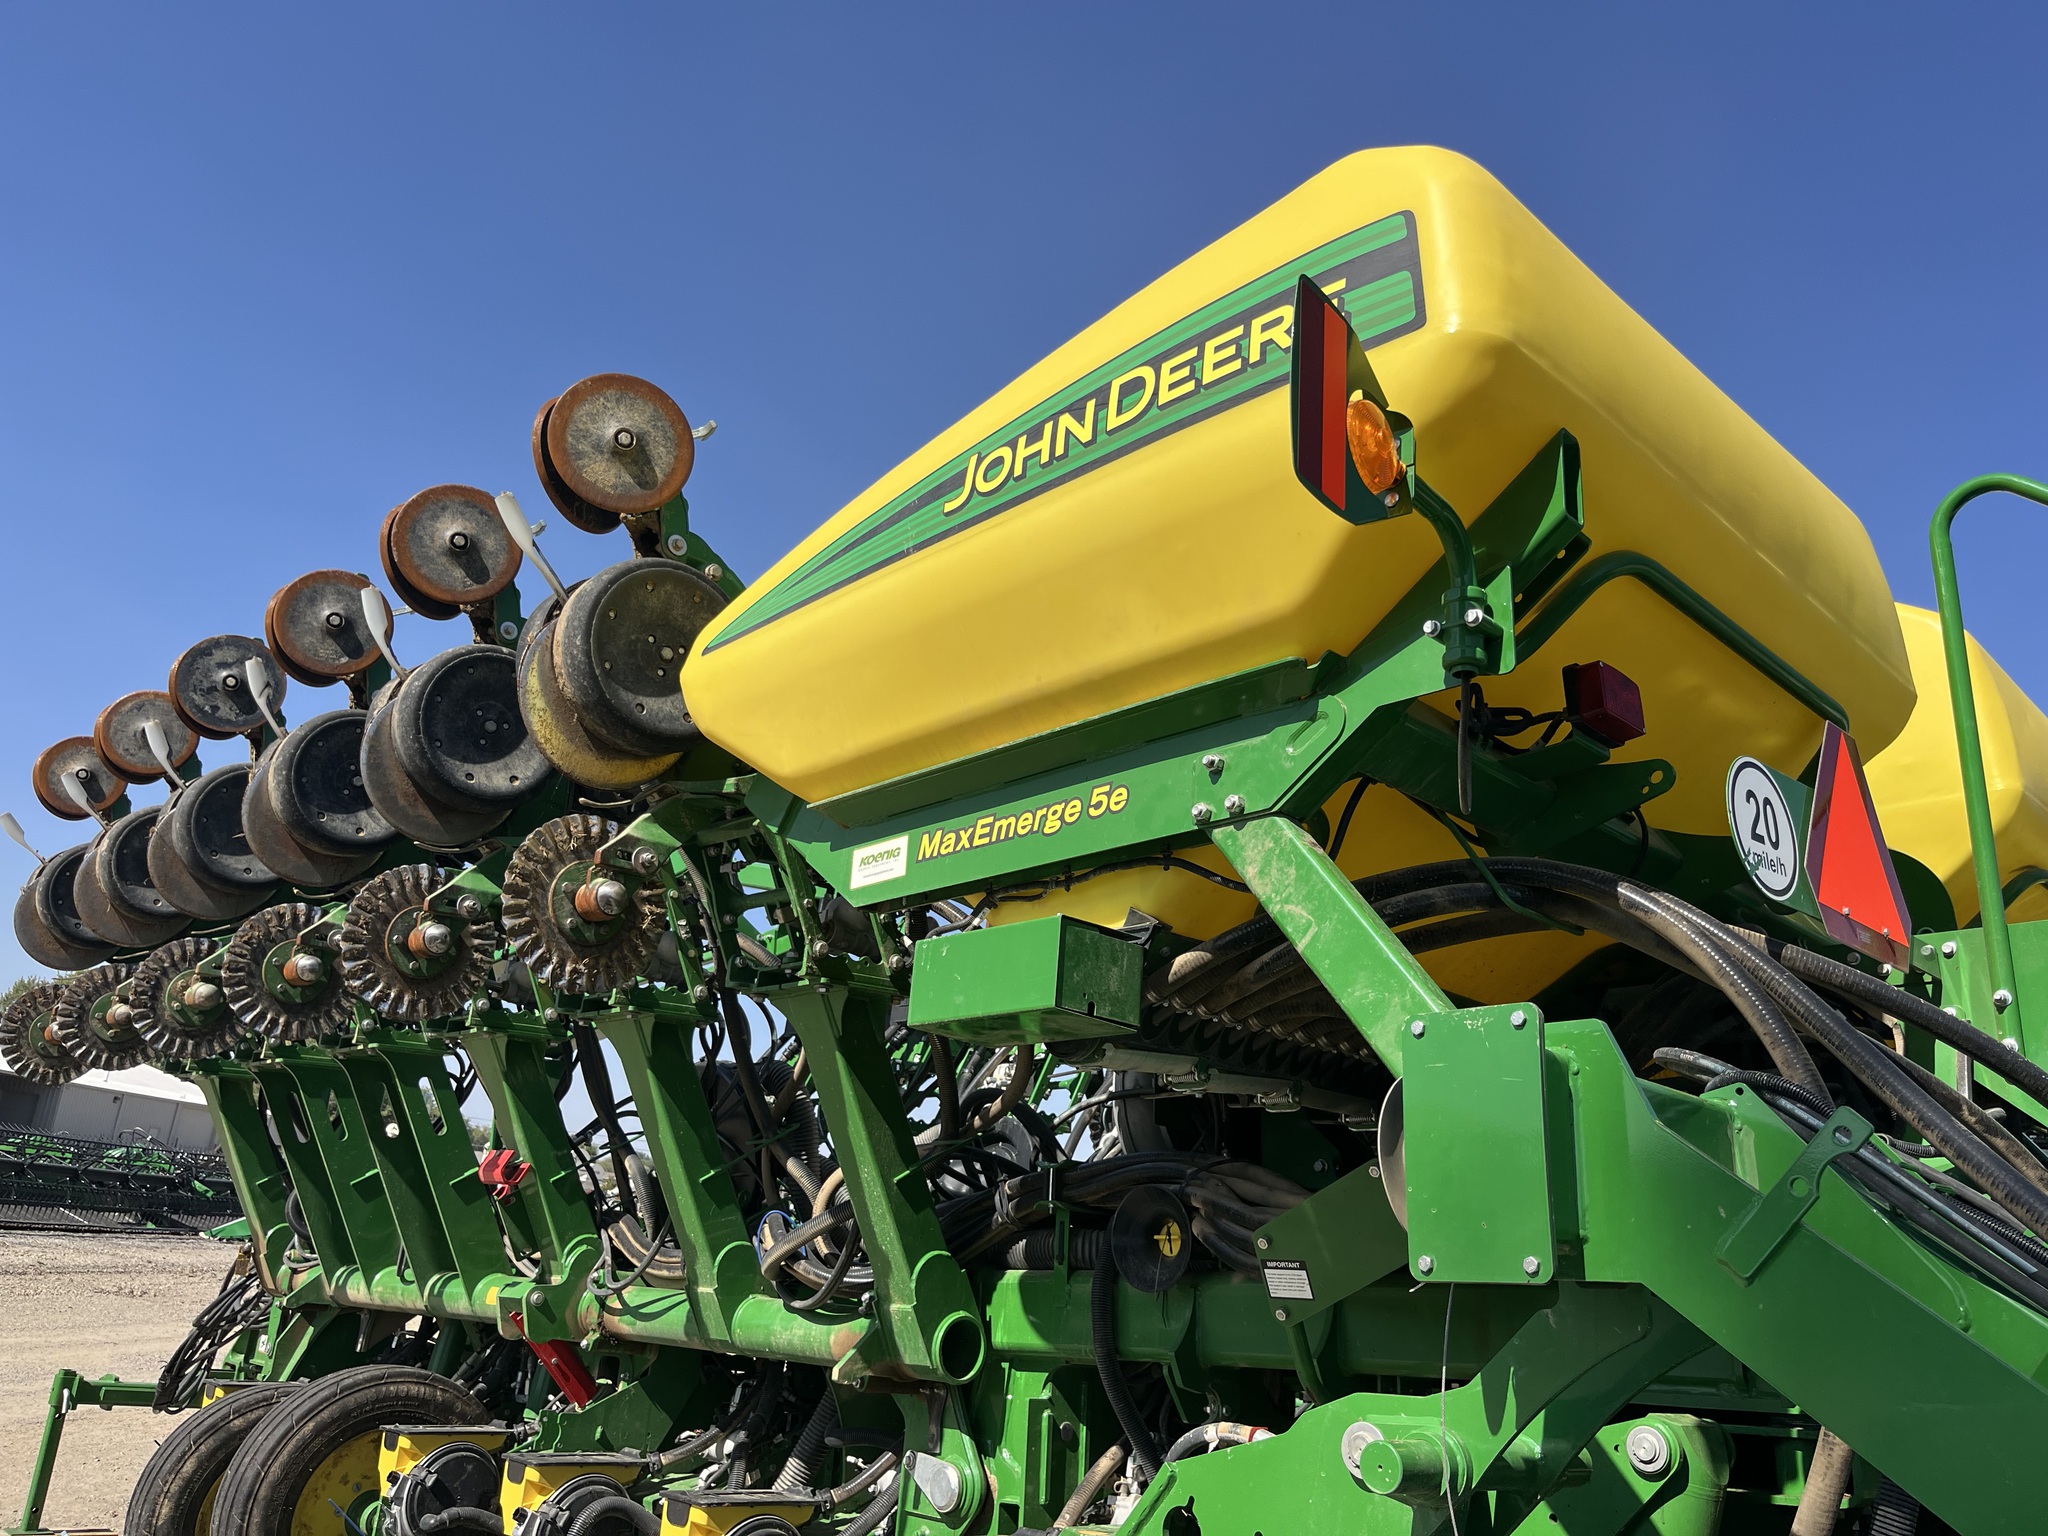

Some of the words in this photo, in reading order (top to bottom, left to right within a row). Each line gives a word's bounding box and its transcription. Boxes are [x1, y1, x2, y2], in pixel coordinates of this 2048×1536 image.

[944, 398, 1097, 515] JOHN
[917, 797, 1082, 861] MaxEmerge
[1088, 784, 1129, 817] 5e
[1745, 789, 1780, 851] 20
